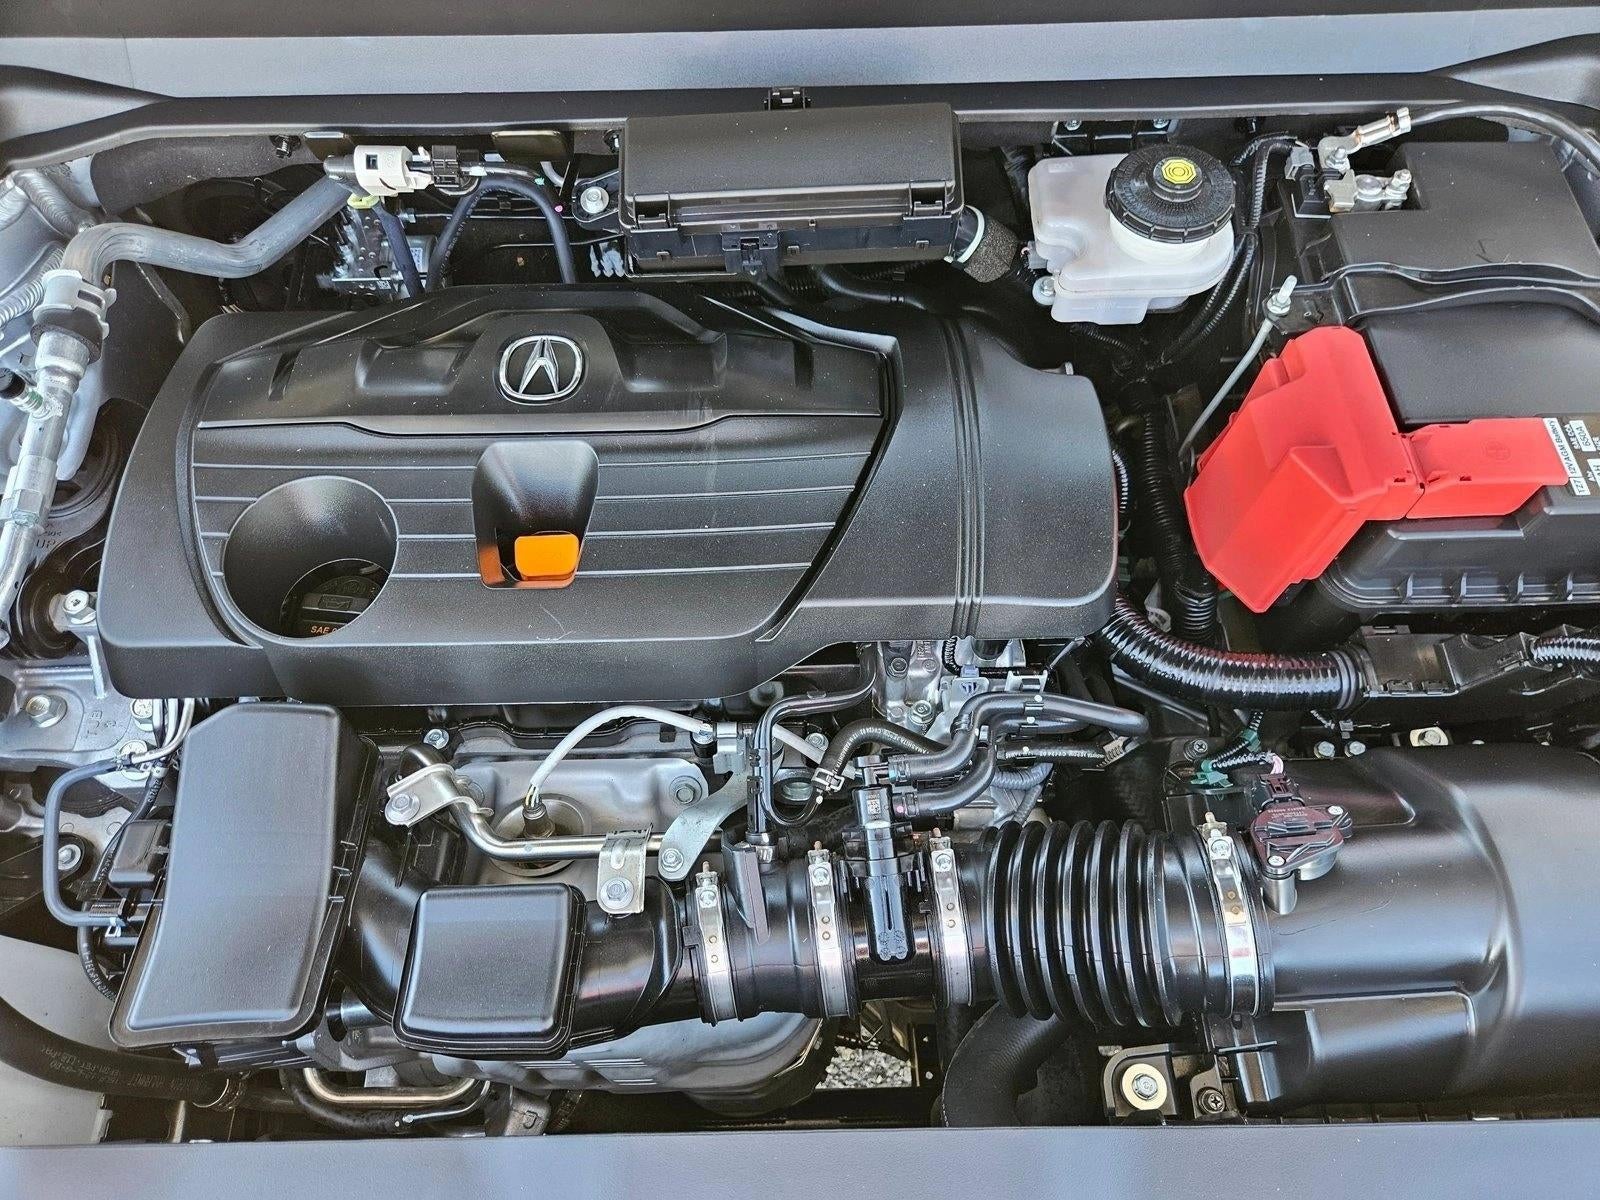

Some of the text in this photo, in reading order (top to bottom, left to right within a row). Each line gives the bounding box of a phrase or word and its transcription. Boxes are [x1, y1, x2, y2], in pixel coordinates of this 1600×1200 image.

[1548, 420, 1562, 443] Battery
[1558, 444, 1572, 462] AGM
[310, 625, 330, 634] SAE
